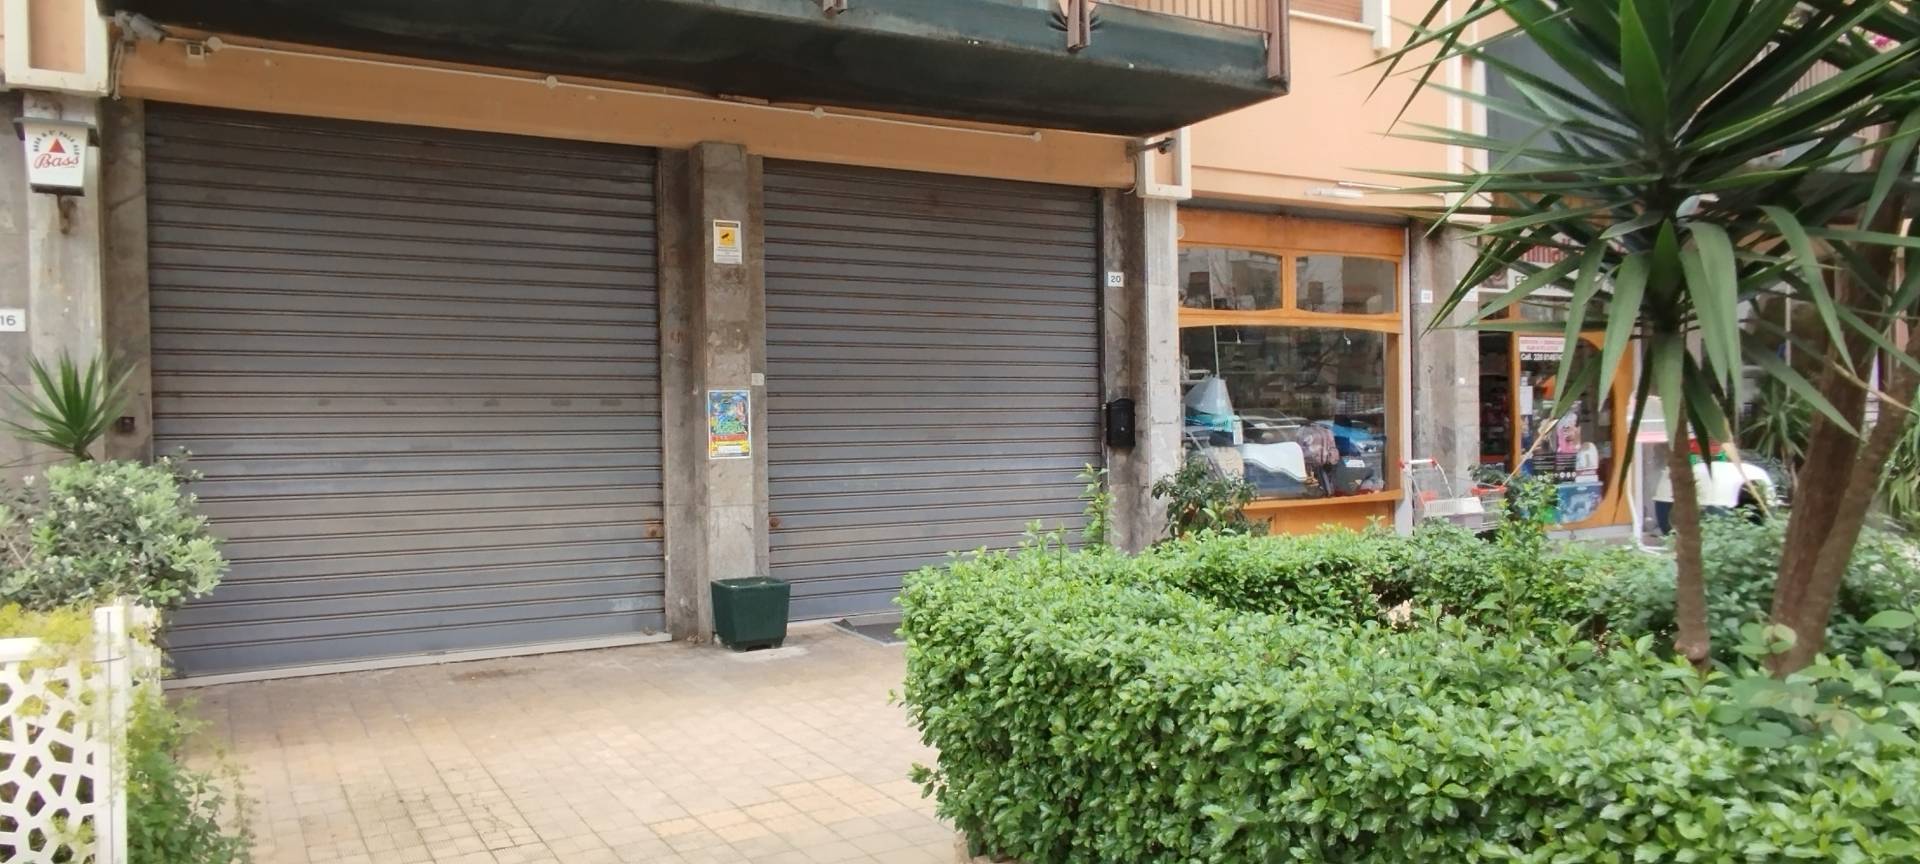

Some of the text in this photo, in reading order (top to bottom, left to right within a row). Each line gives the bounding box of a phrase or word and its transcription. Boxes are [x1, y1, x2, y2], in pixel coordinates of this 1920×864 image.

[34, 152, 80, 169] Bass
[1110, 275, 1121, 283] 20
[0, 314, 16, 326] 16
